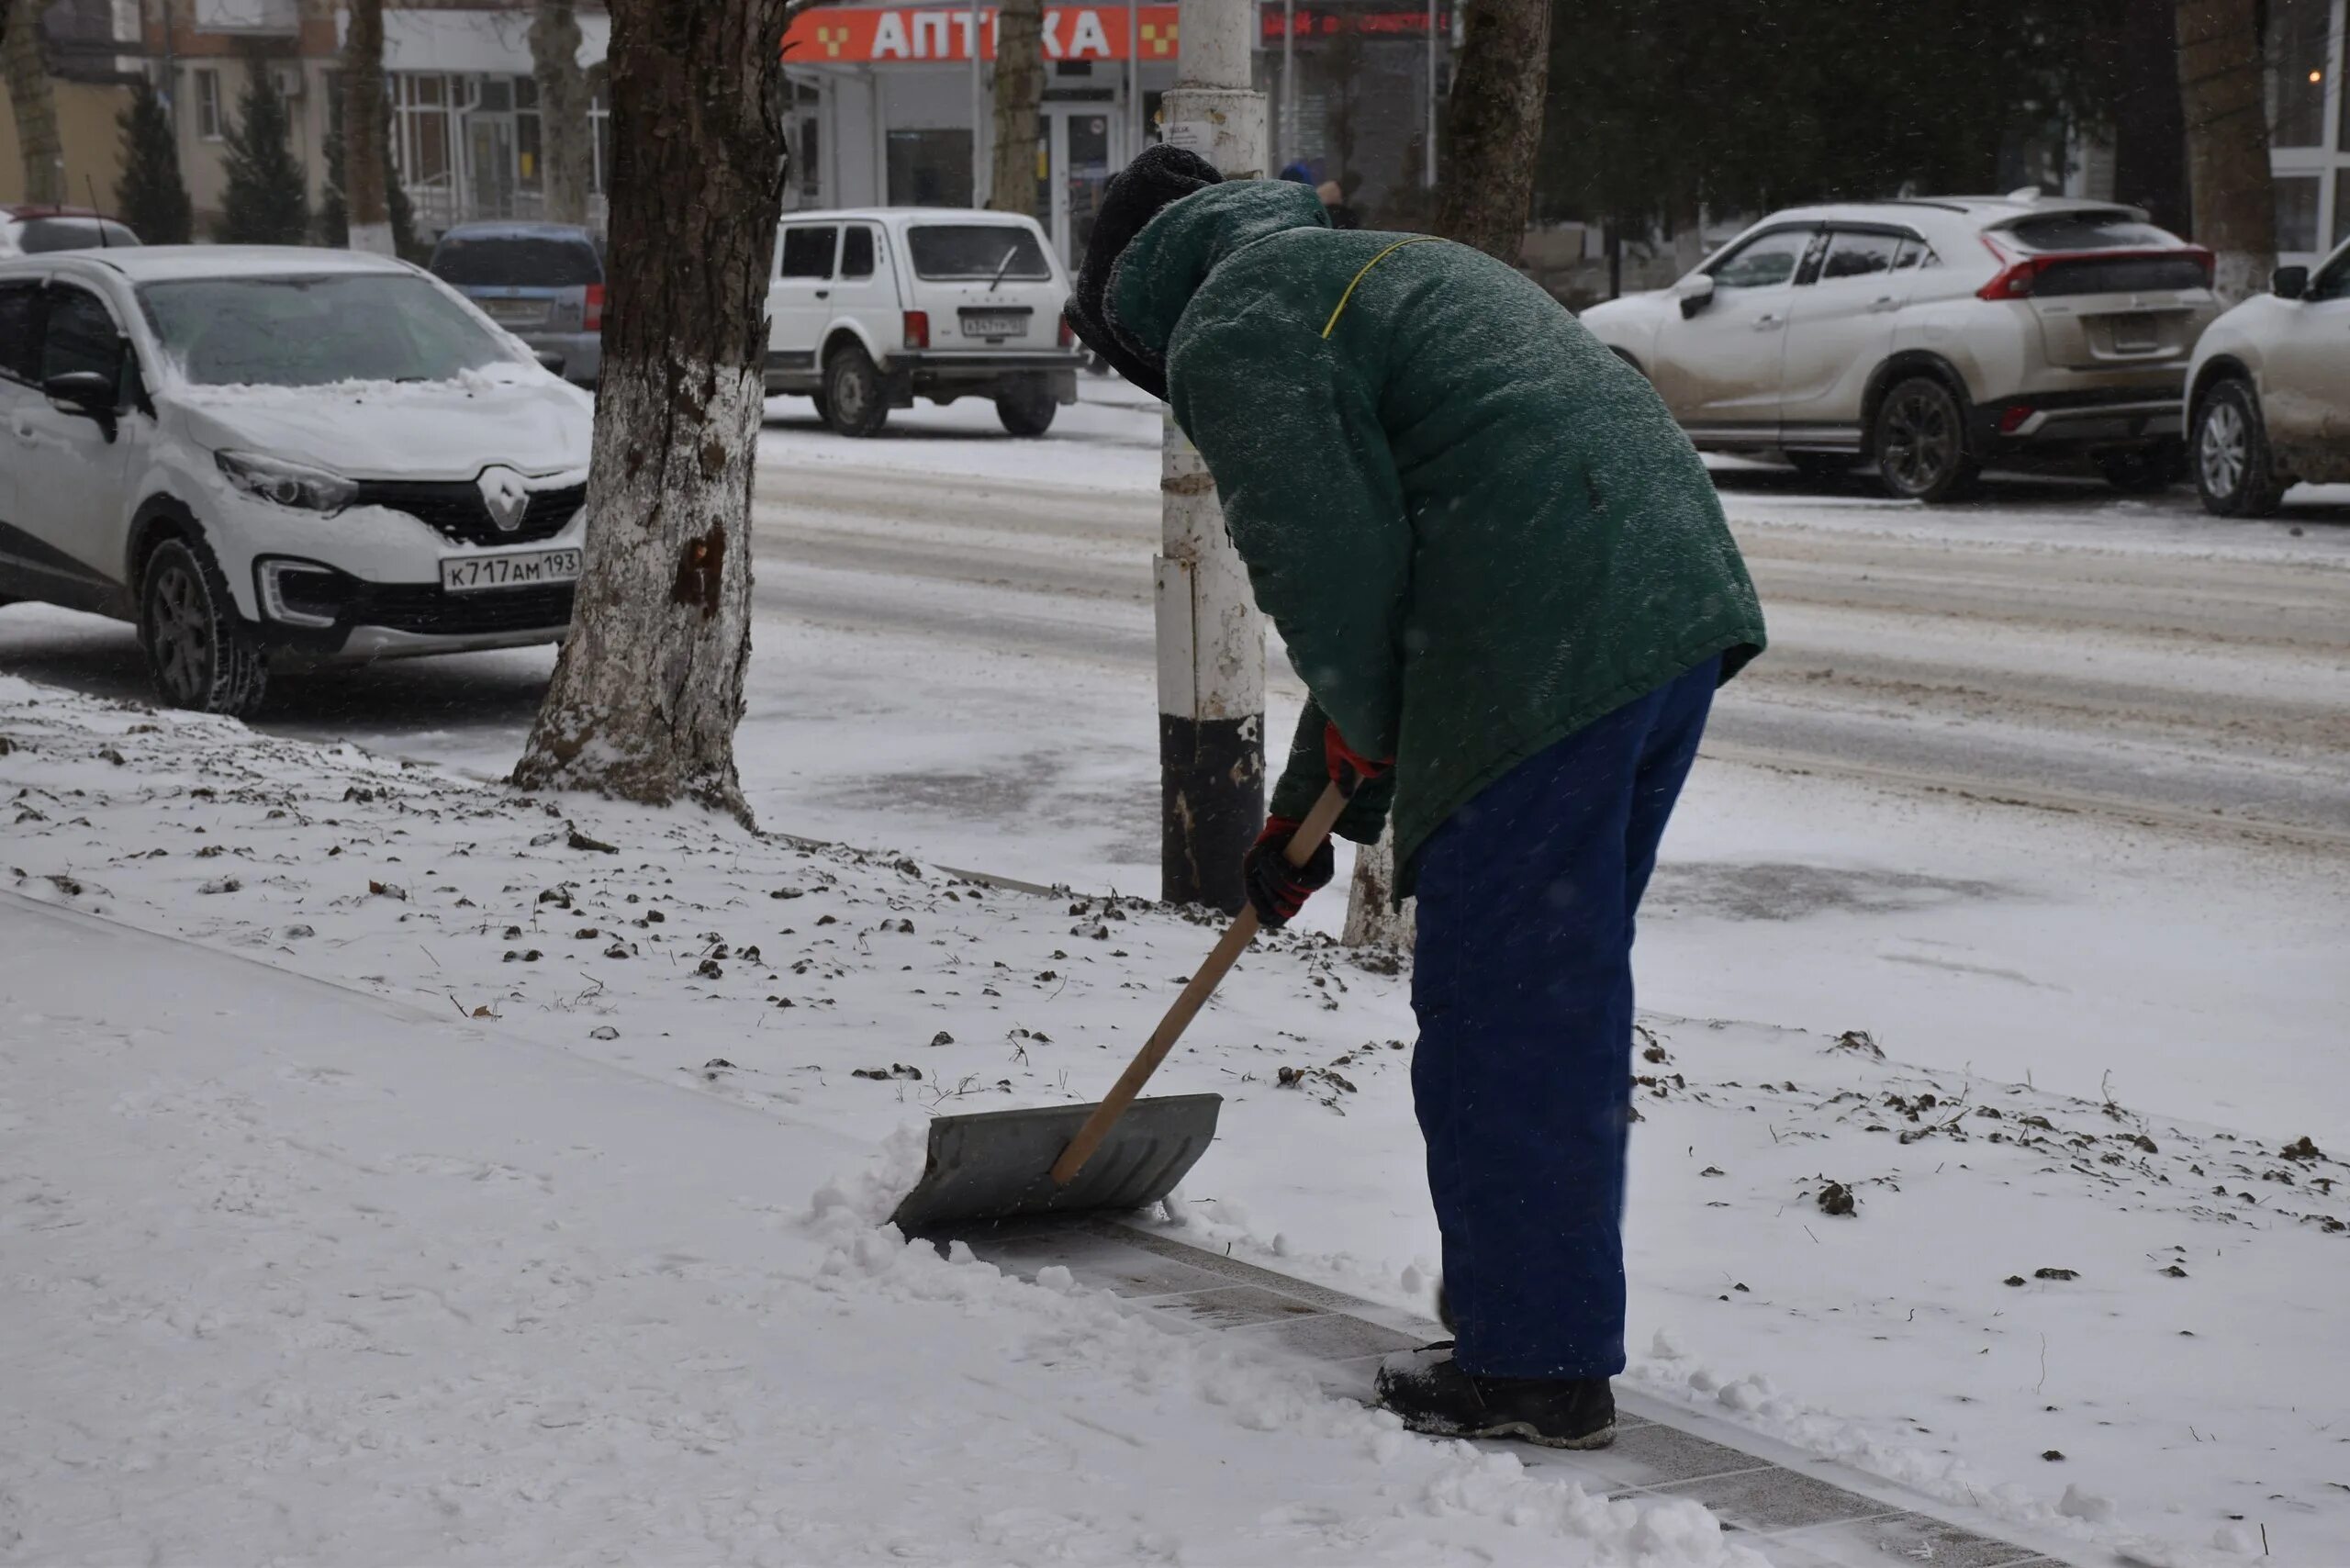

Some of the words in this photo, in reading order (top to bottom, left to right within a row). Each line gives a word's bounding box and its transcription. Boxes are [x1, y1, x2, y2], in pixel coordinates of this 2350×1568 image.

[872, 11, 1110, 59] АПТКА
[452, 558, 541, 586] К717АМ
[543, 554, 576, 574] 193
